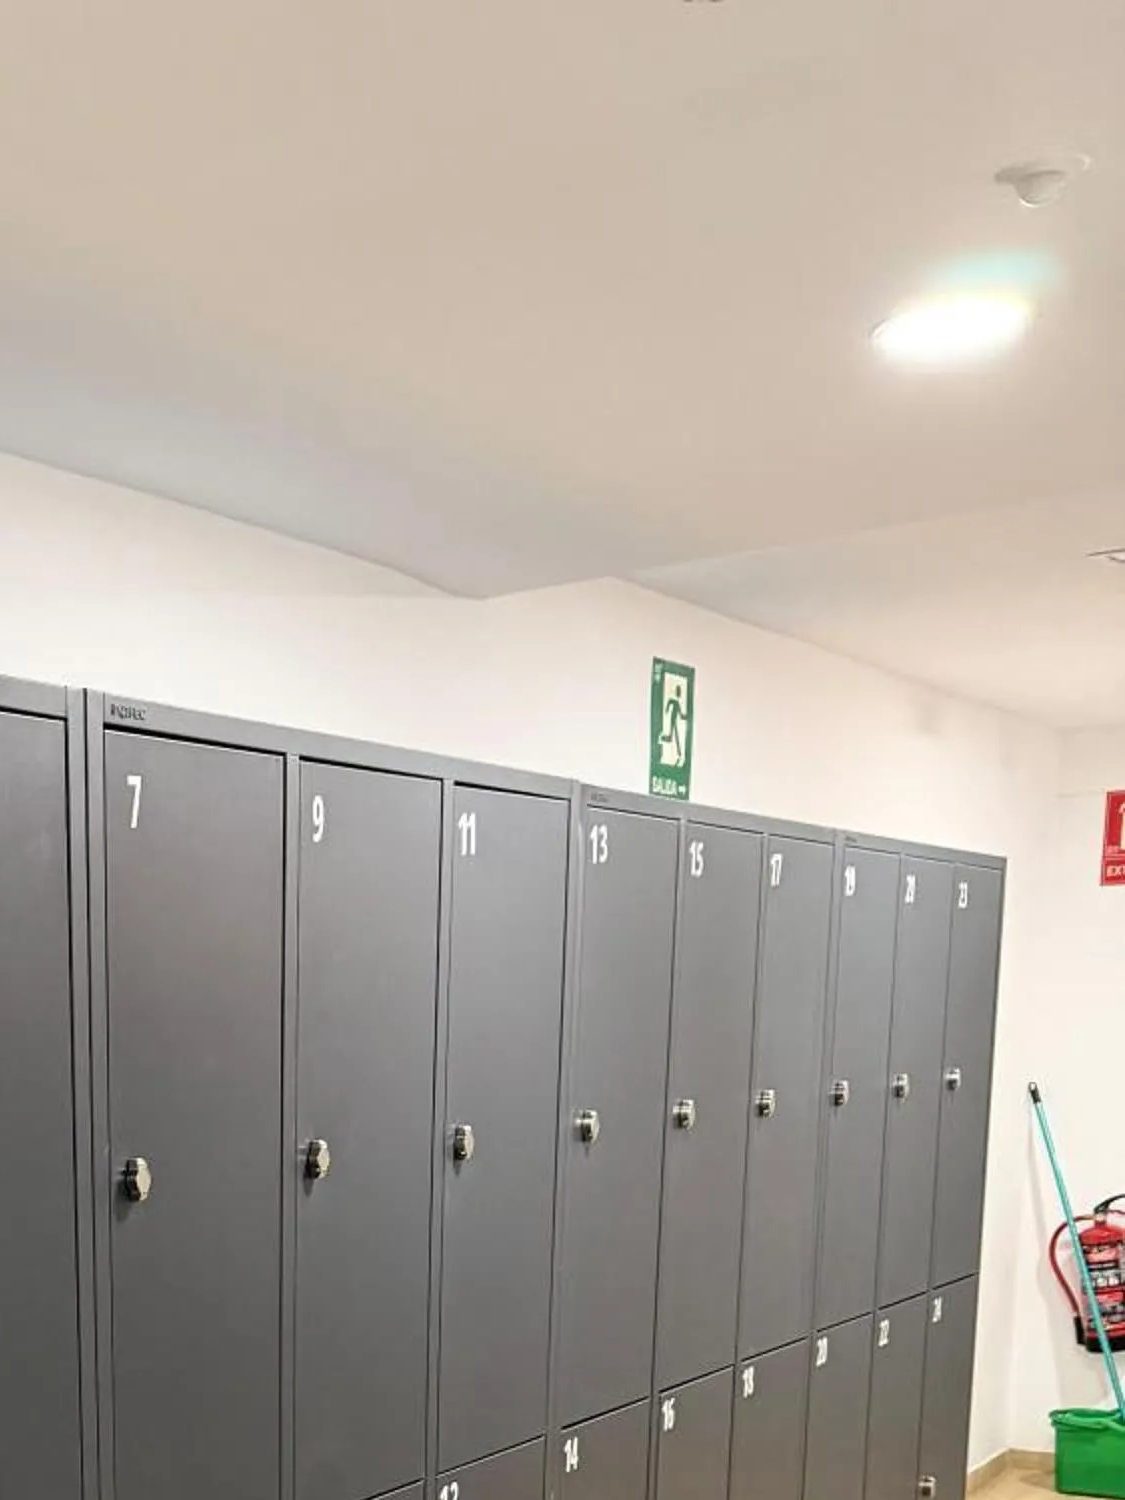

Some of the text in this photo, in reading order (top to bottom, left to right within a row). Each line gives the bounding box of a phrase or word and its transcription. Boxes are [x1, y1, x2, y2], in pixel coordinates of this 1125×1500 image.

[126, 775, 142, 829] 7
[312, 795, 325, 843] 9
[458, 812, 476, 856] 11
[589, 824, 608, 865] 13
[689, 841, 704, 877] 15
[770, 853, 783, 888] 17
[661, 1397, 676, 1431] 16
[562, 1437, 579, 1473] 14
